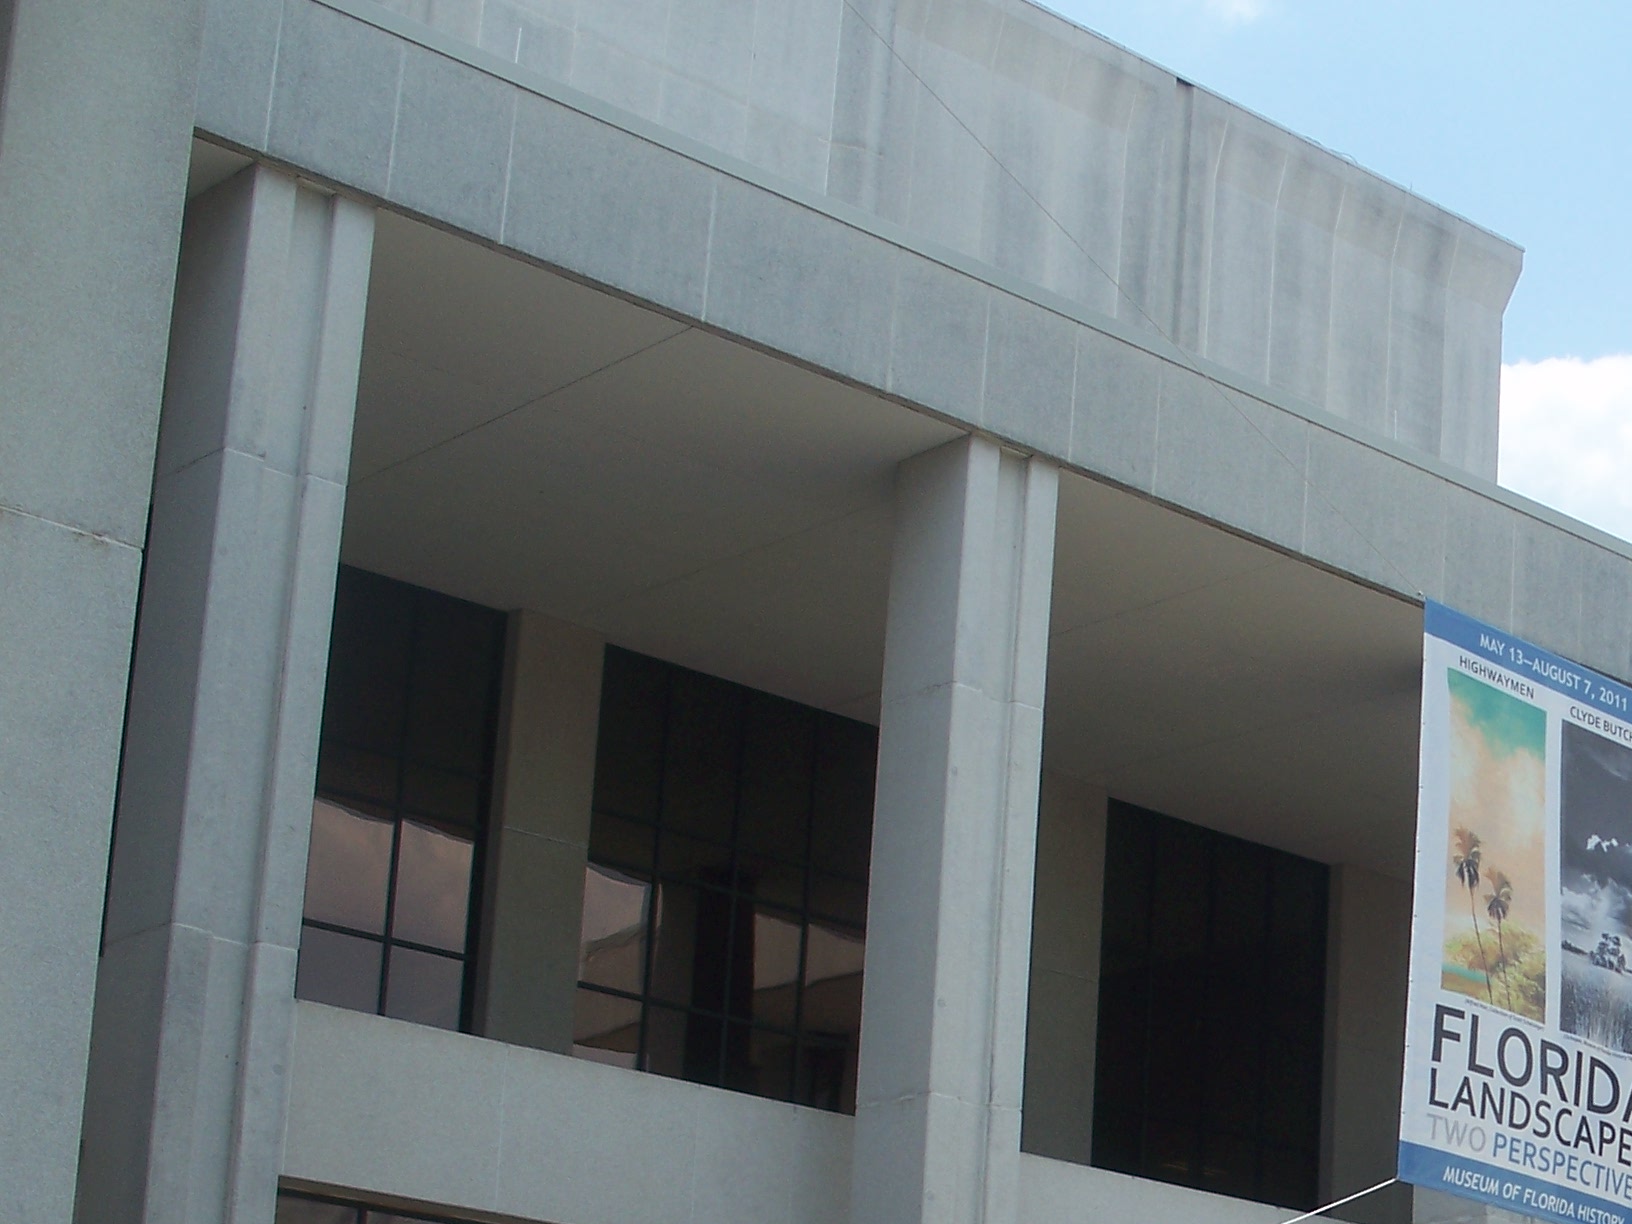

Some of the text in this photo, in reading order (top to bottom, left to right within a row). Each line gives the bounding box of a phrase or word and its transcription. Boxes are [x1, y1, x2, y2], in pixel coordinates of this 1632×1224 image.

[1459, 655, 1535, 700] HIGHWAYMEN
[1480, 633, 1505, 656] MAY
[1583, 679, 1596, 700] 7,
[1599, 686, 1628, 712] 2011
[1569, 705, 1602, 730] CLYDE
[1427, 1113, 1487, 1153] TWO
[1442, 1165, 1499, 1197] MUSEUM
[1502, 1181, 1520, 1201] OF
[1523, 1188, 1575, 1220] FLORIDA
